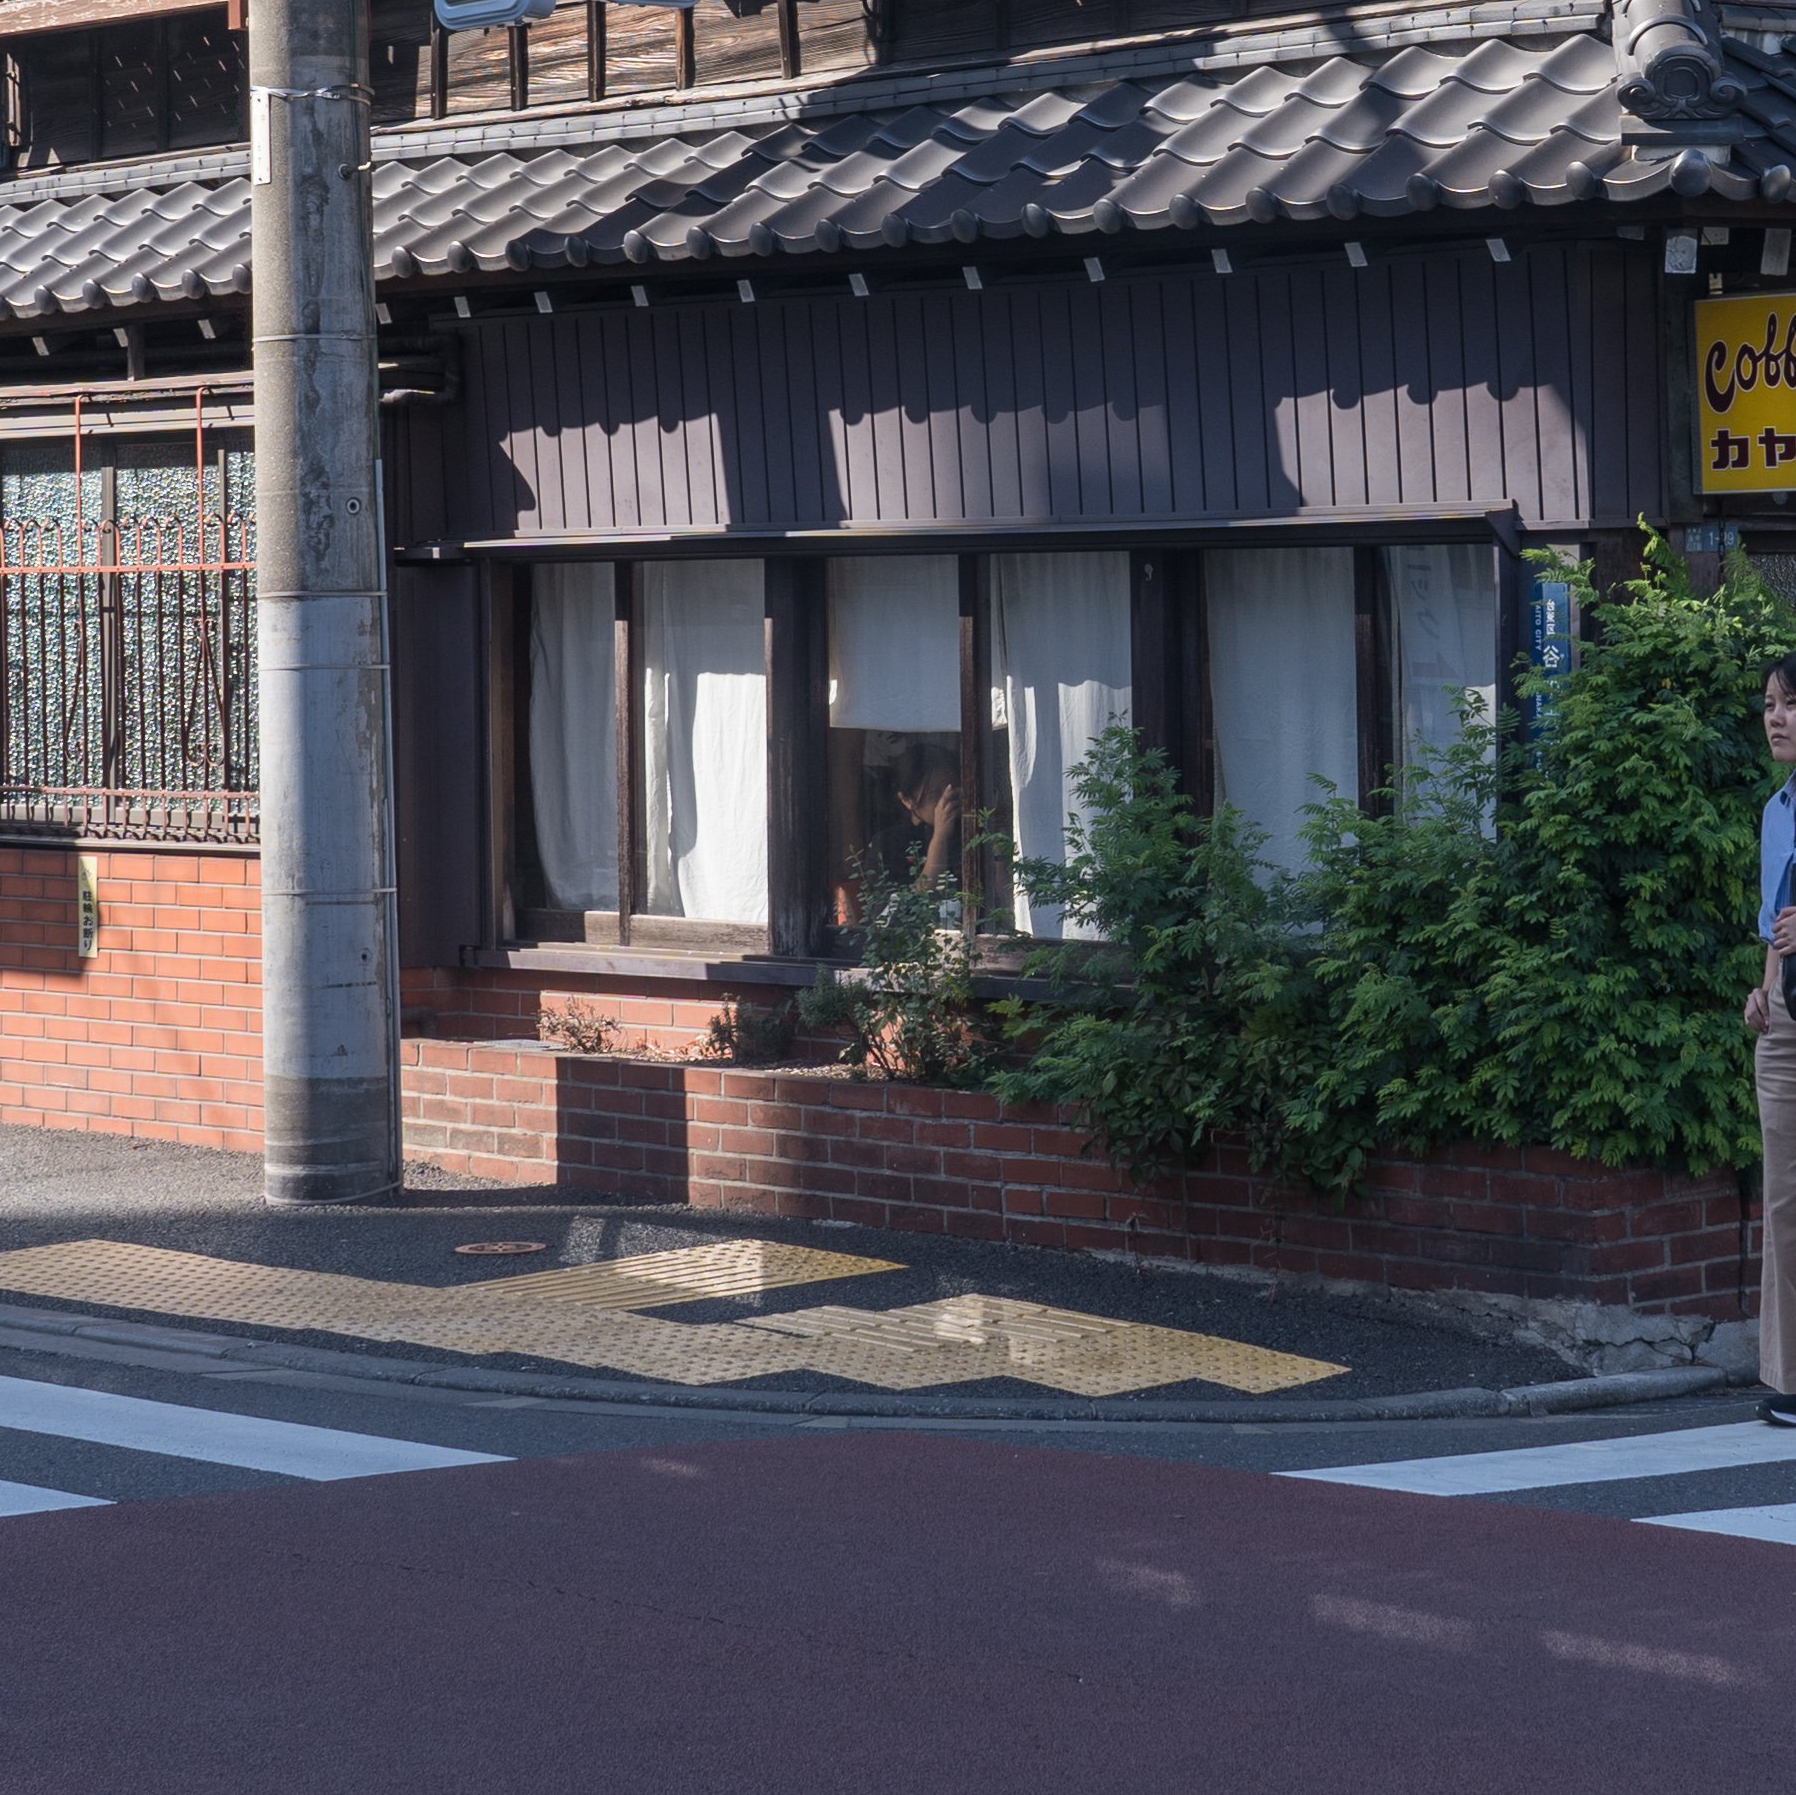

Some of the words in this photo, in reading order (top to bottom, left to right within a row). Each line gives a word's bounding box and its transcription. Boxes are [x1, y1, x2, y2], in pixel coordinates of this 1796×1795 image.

[1534, 604, 1542, 626] AITO
[1534, 629, 1542, 651] CITY
[82, 890, 94, 951] 駐輪お断り
